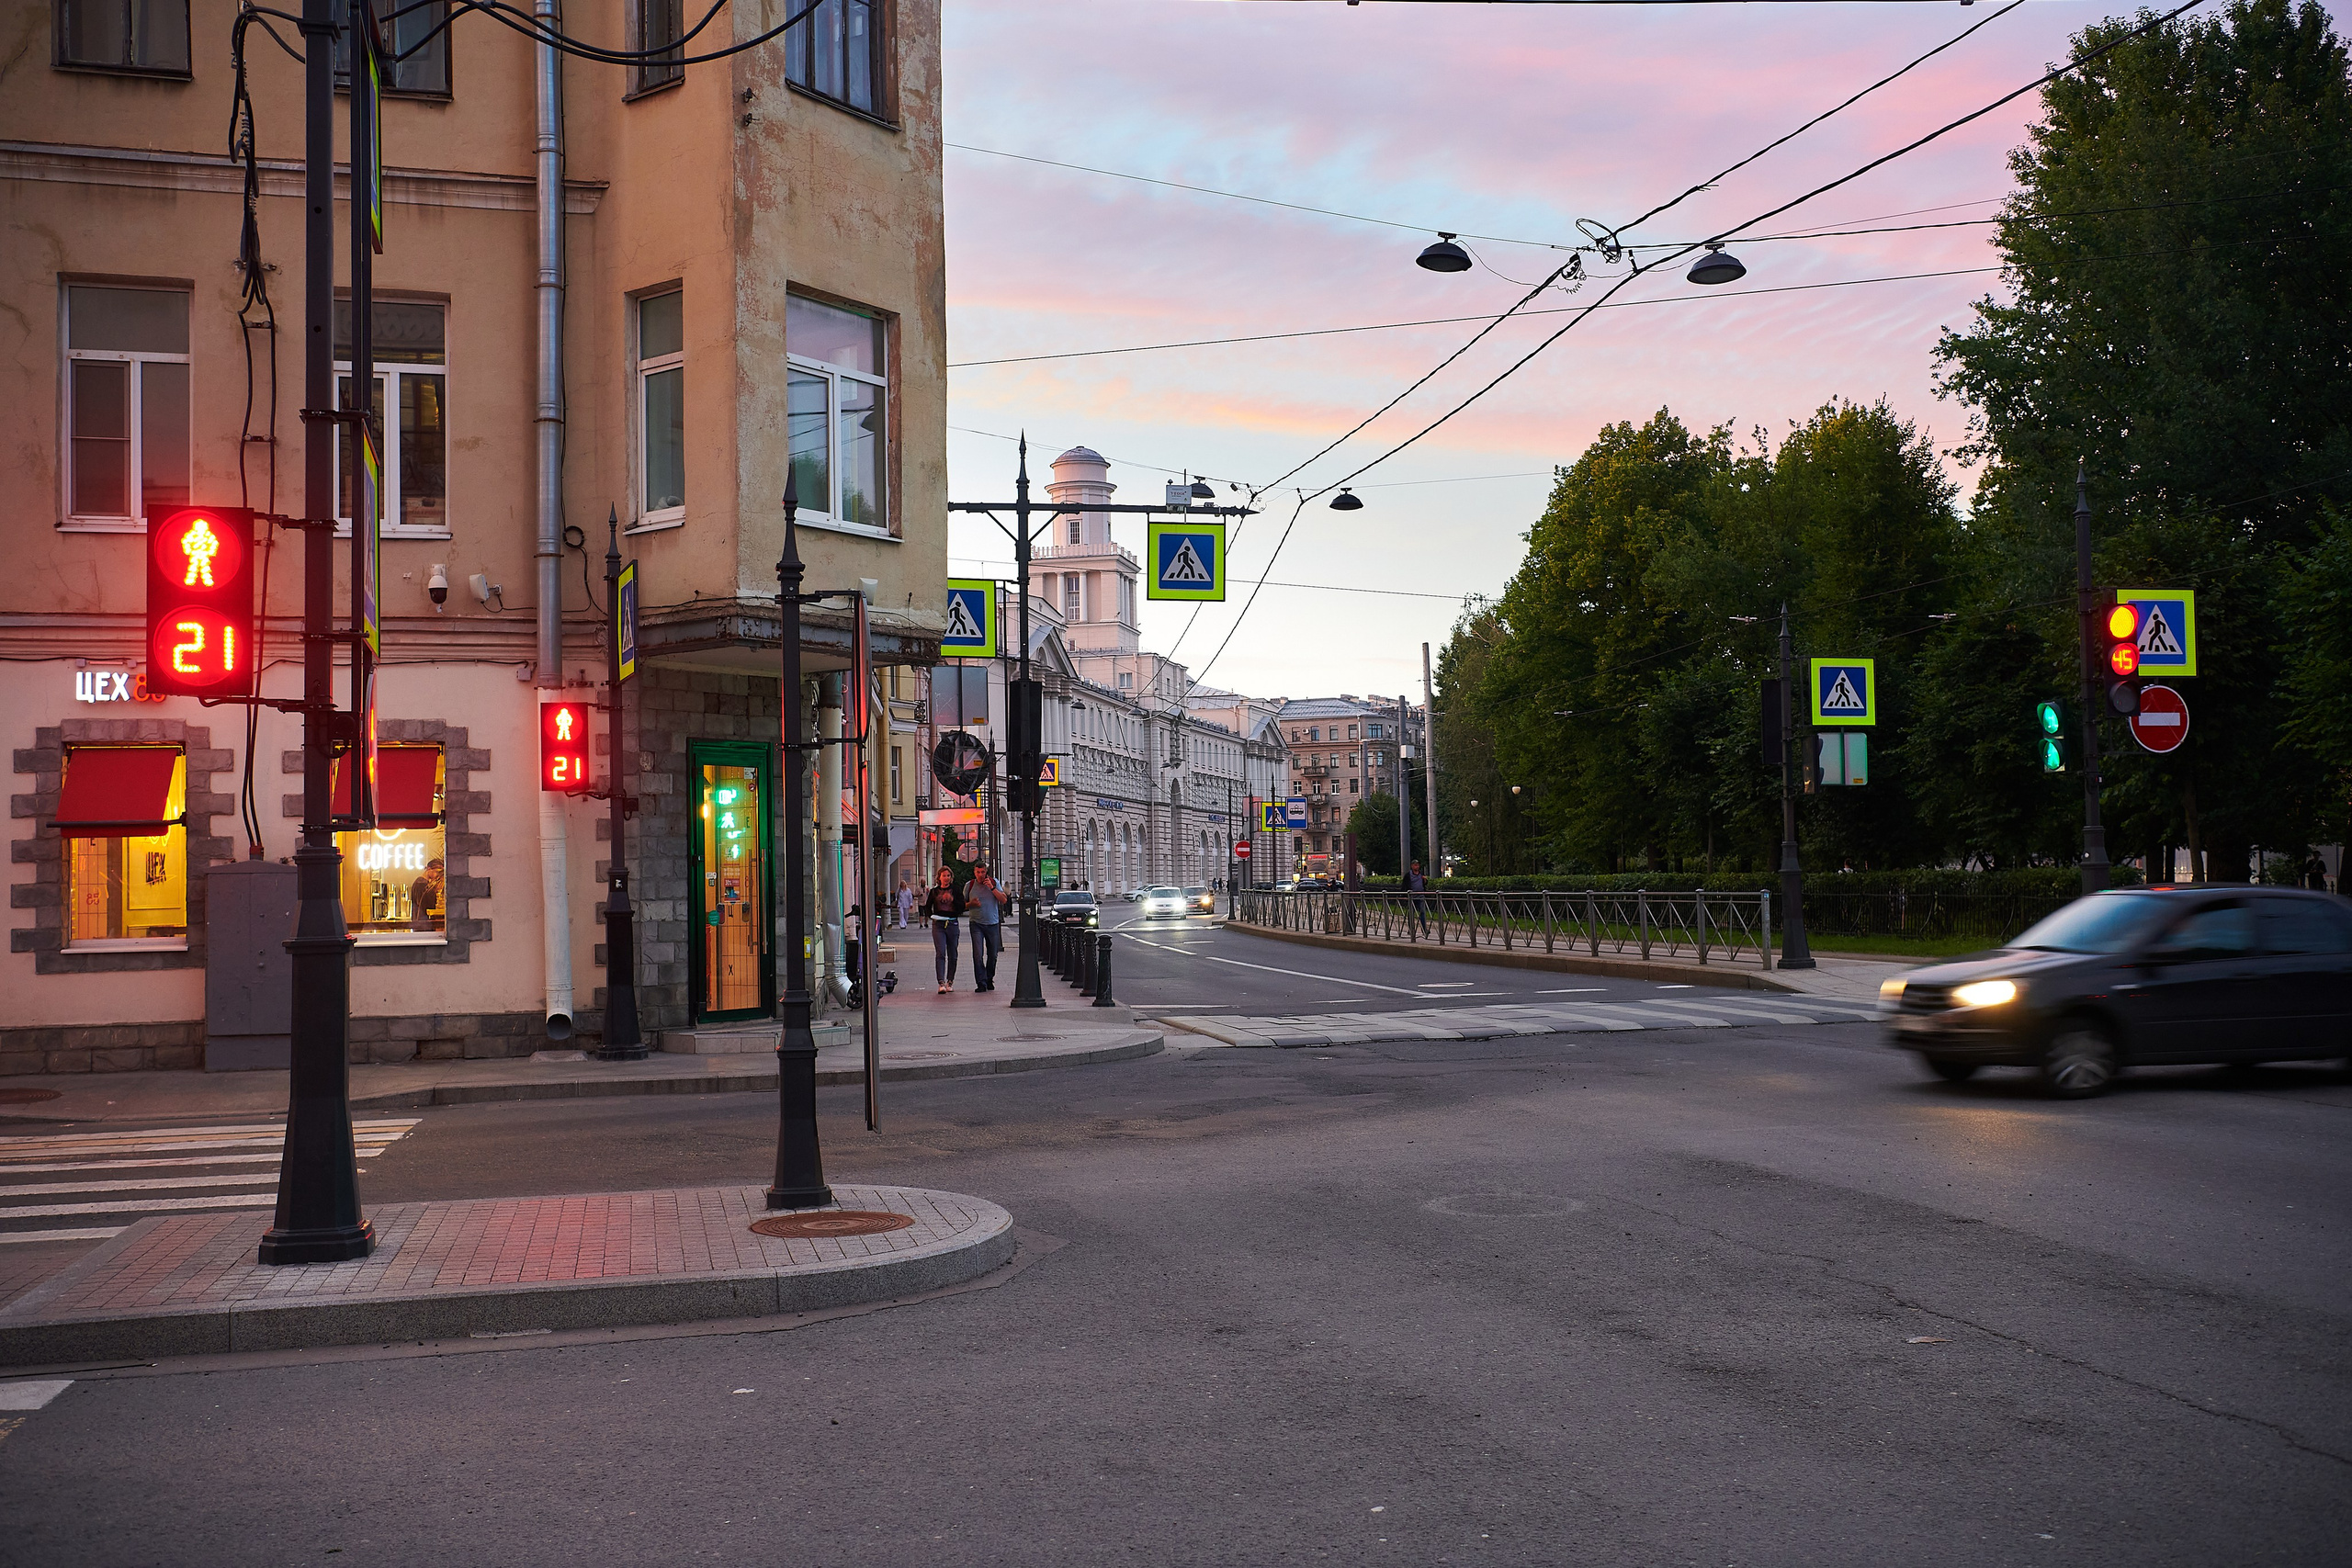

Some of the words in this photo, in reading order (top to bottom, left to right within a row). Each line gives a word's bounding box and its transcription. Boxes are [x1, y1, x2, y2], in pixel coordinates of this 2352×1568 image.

[173, 622, 234, 673] 21
[2112, 649, 2132, 671] 45
[75, 671, 130, 704] ЦЕХ
[552, 756, 581, 782] 21
[358, 843, 424, 870] COFFEE
